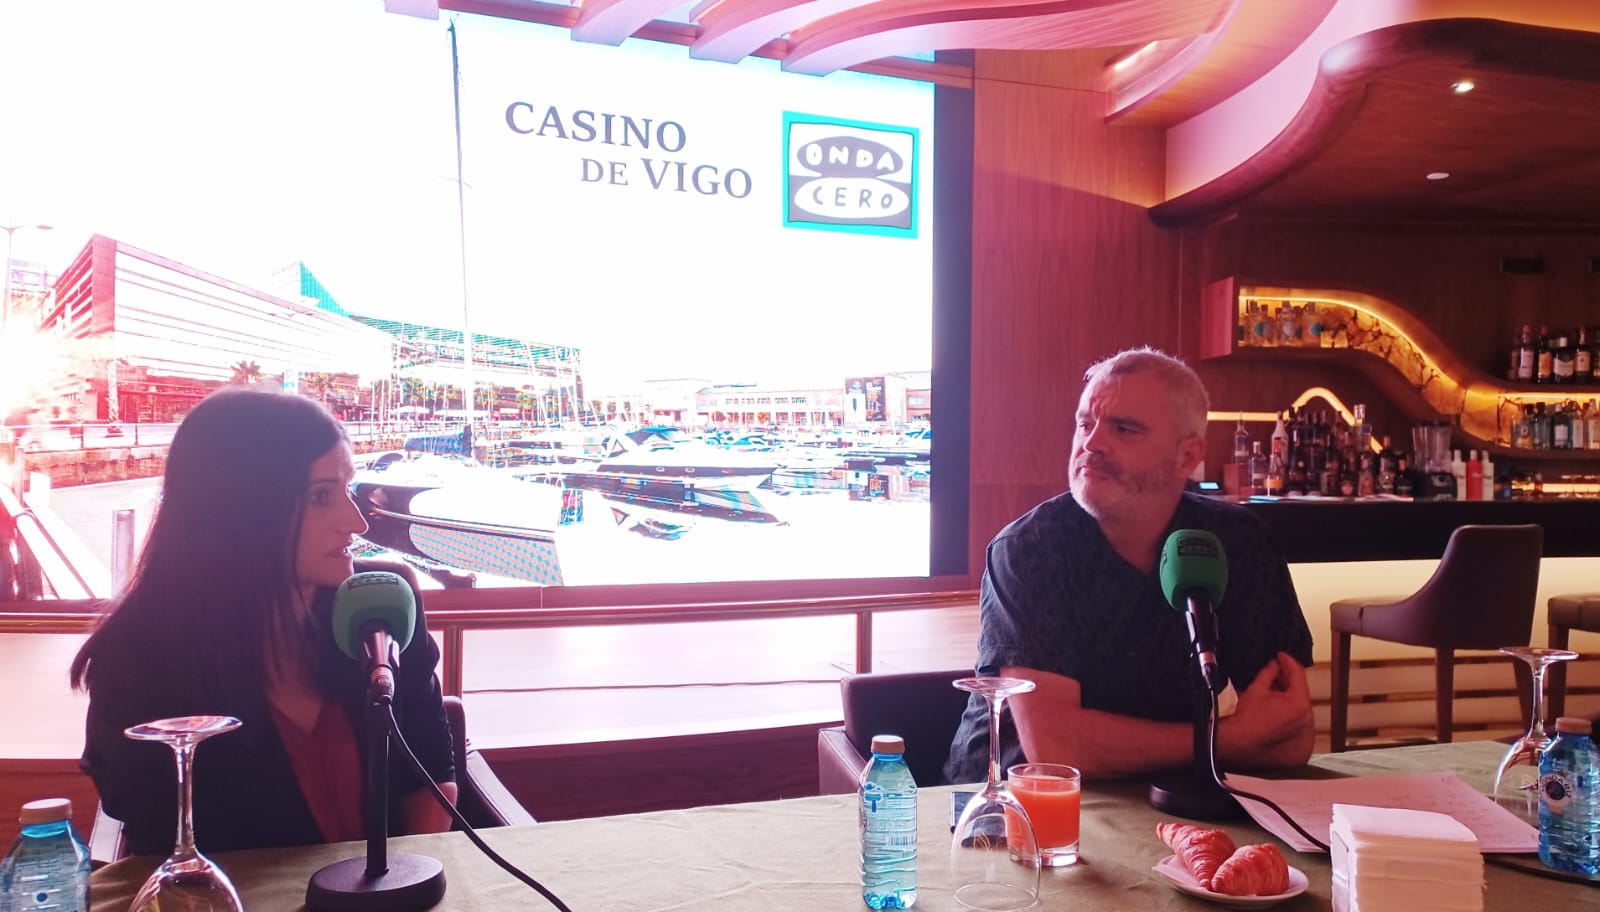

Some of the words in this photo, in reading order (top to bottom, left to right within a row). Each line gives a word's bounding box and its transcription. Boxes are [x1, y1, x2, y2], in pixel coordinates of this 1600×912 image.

[505, 101, 687, 153] CASINO
[806, 143, 895, 171] ONDA
[581, 157, 629, 186] DE
[640, 157, 753, 199] VIGO
[812, 185, 893, 209] CERO
